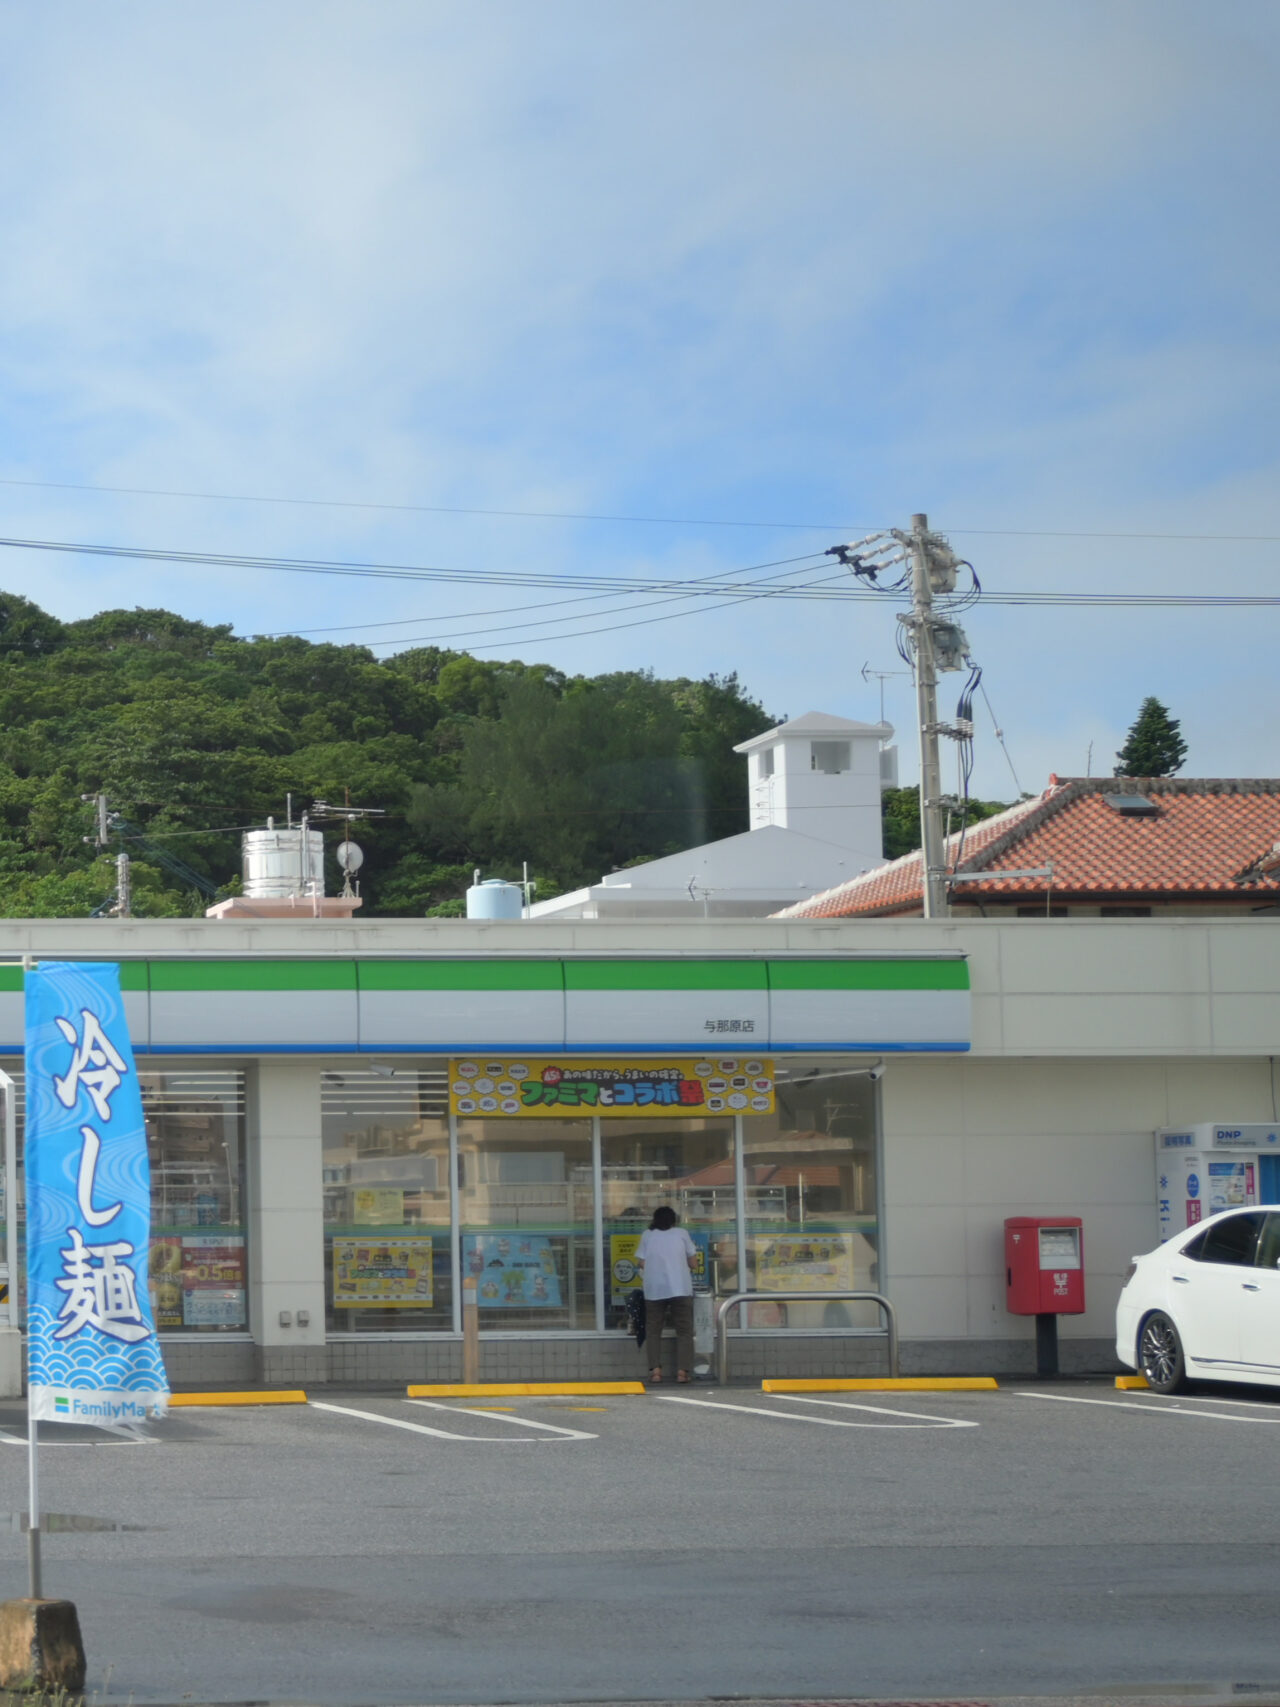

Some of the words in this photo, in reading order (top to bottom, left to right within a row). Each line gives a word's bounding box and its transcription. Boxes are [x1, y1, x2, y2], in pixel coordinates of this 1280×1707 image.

[703, 1019, 755, 1033] 与那原店
[520, 1080, 705, 1106] ファミマとコラボ祭
[1217, 1130, 1241, 1139] DNP
[54, 1008, 152, 1342] 冷し麺
[73, 1399, 160, 1418] FamilyMat
